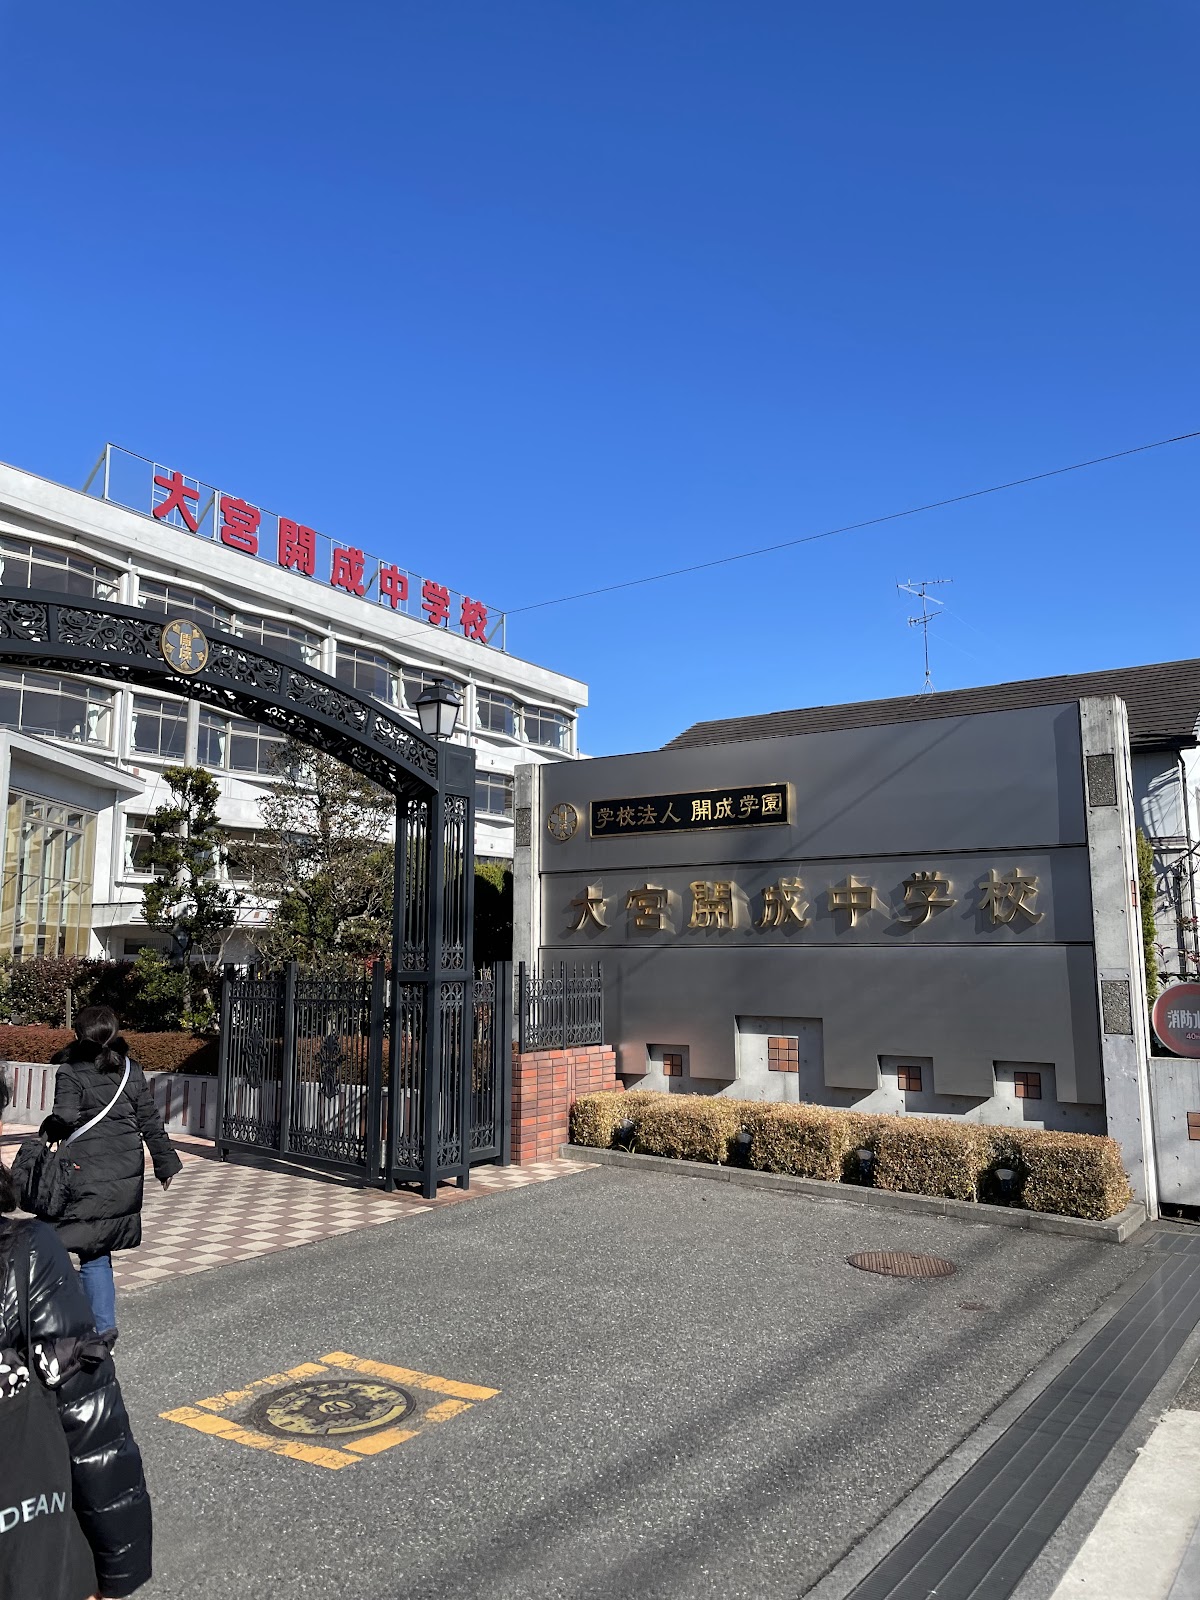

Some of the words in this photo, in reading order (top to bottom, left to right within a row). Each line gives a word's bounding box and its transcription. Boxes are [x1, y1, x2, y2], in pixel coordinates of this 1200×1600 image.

[152, 472, 487, 643] 大宮開成中学校
[595, 802, 682, 829] 学校法人
[690, 793, 782, 822] 開成学園
[567, 868, 1045, 931] 大宮開成中学校
[0, 1491, 66, 1534] DEAN
